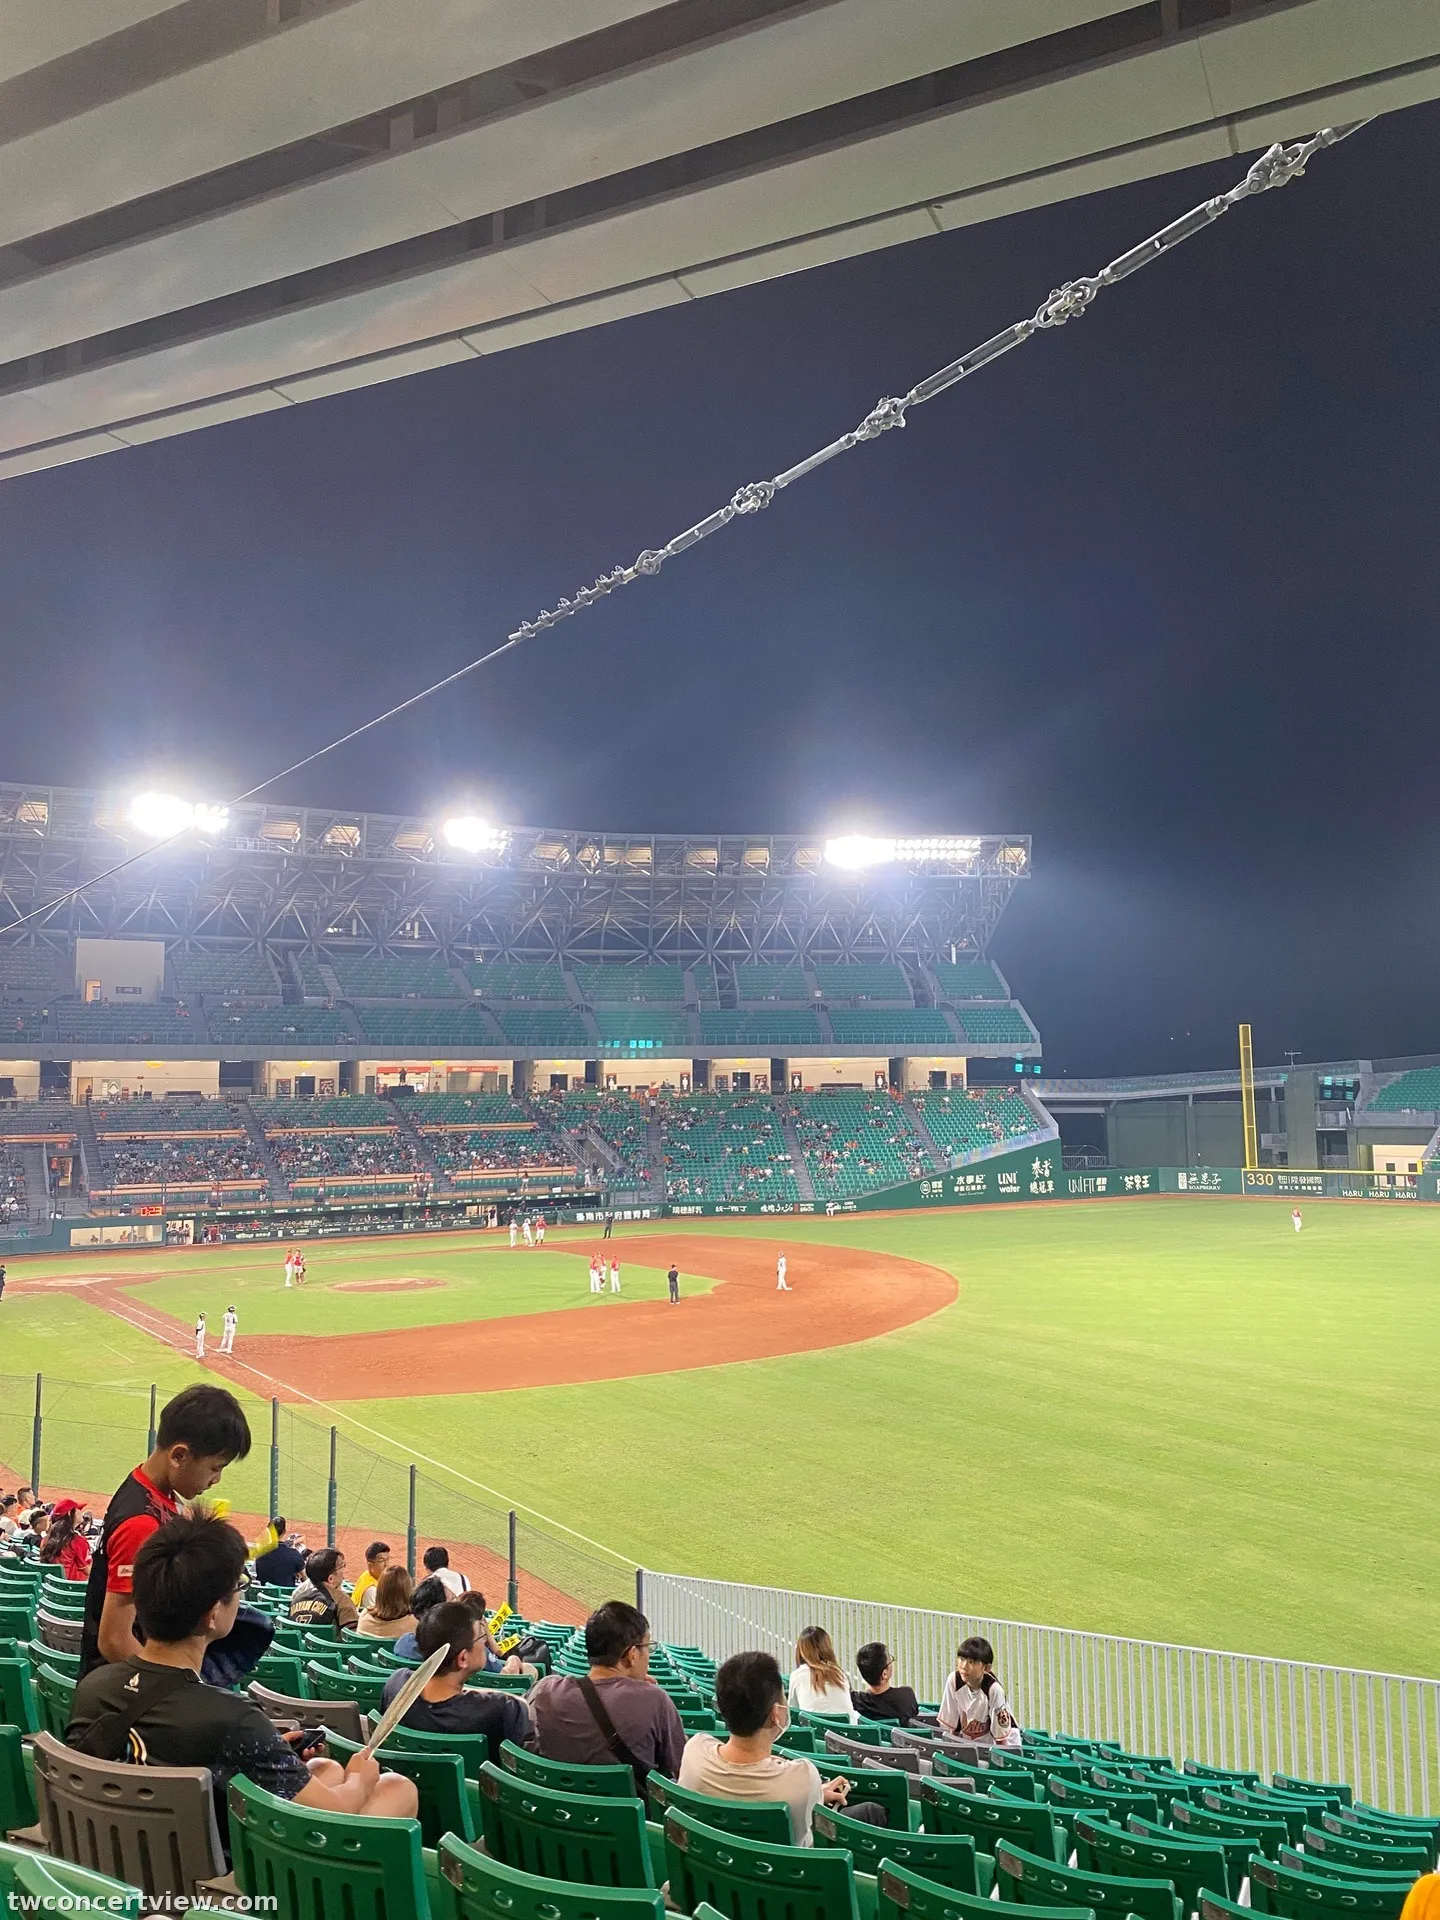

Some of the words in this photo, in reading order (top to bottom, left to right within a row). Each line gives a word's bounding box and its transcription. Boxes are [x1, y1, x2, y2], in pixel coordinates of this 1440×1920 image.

[997, 1172, 1018, 1184] UNI
[1247, 1173, 1274, 1186] 330
[999, 1185, 1020, 1194] water
[1395, 1191, 1417, 1199] HARU
